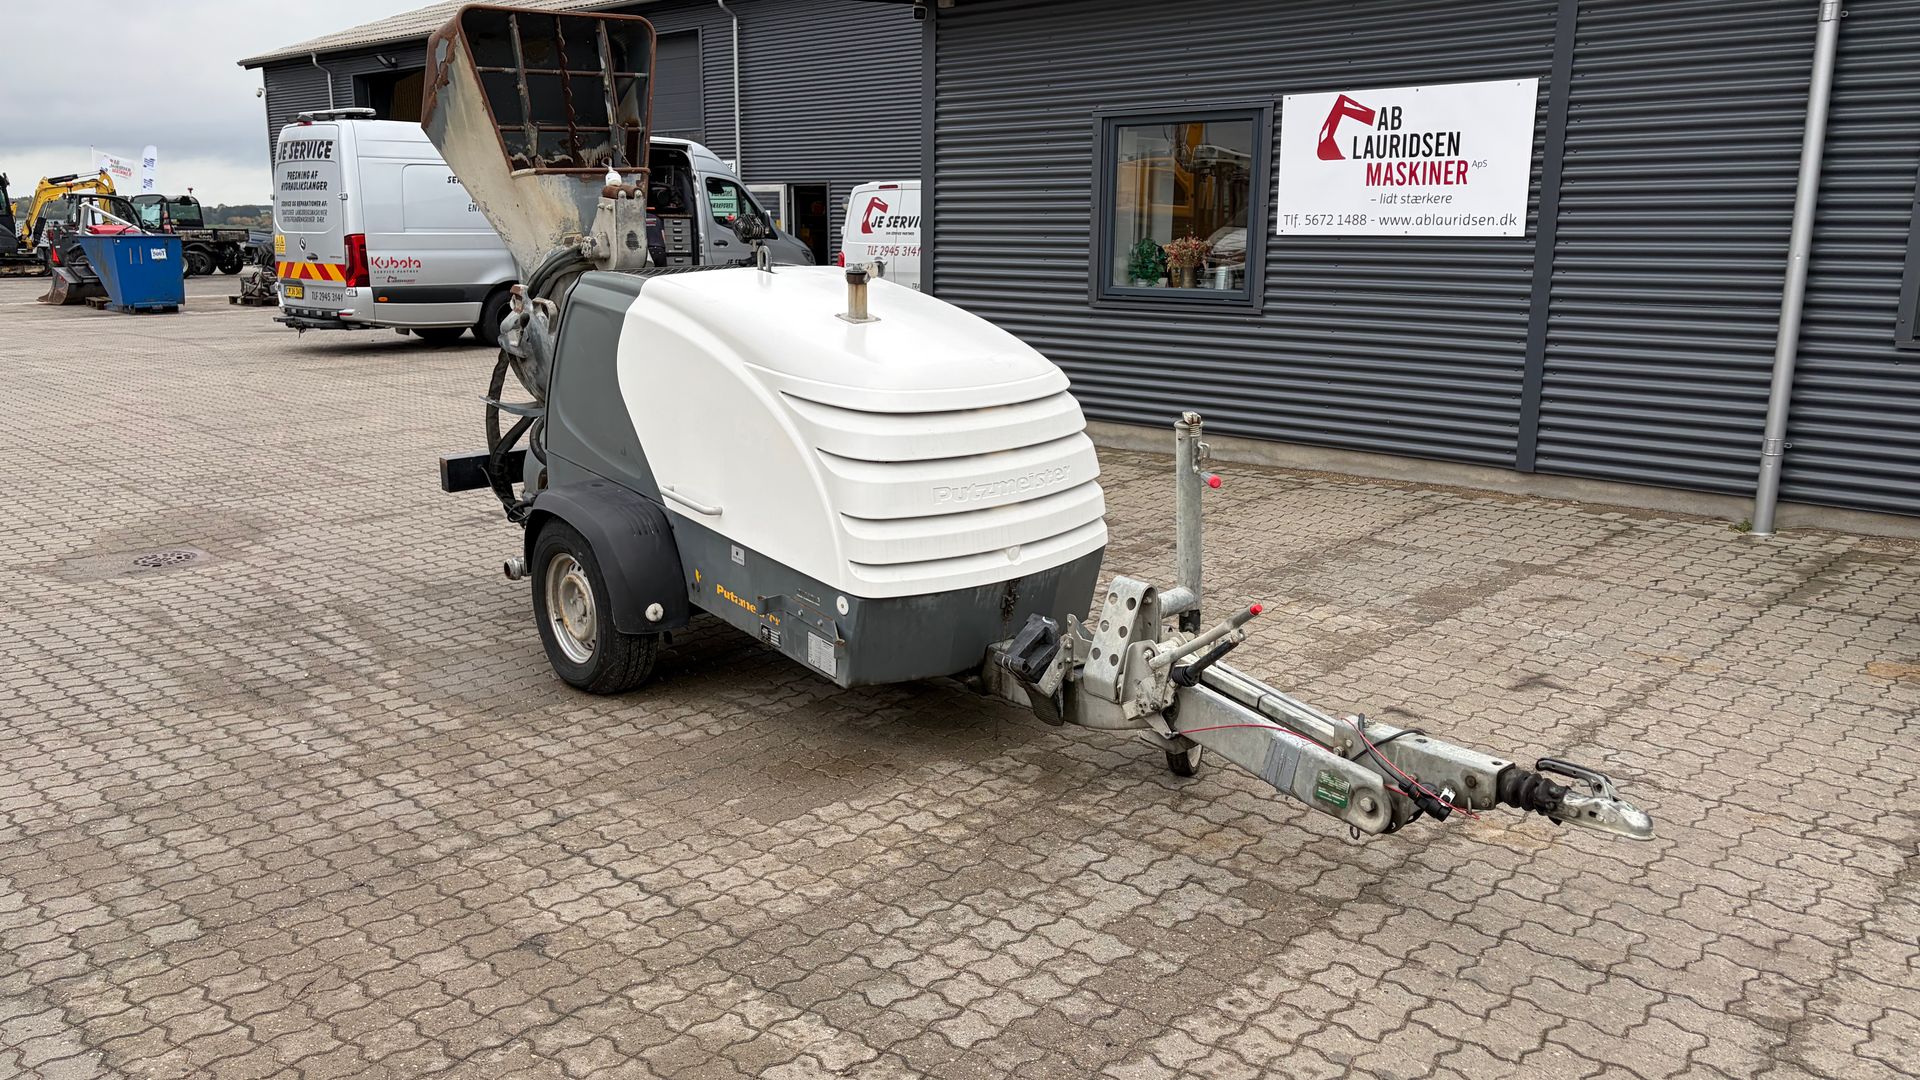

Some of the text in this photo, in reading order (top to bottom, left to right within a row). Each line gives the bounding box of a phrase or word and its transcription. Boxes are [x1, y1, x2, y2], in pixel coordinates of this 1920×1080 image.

[1377, 105, 1403, 131] AB
[278, 140, 334, 160] JE SERVICE
[1352, 131, 1461, 160] LAURIDSEN
[286, 170, 318, 180] PRESNING AF
[1365, 160, 1488, 187] MASKINER ApS
[1379, 193, 1398, 205] lidt
[1400, 193, 1453, 205] stærkere
[871, 216, 921, 229] JE SERVI
[1284, 214, 1301, 228] Tlf.
[1304, 214, 1334, 226] 5672
[1337, 214, 1367, 226] 1488
[1379, 213, 1518, 226] www.ablauridsen.dk
[867, 246, 921, 256] TLF 2945 3141
[371, 256, 421, 269] Kubota
[319, 292, 331, 301] 2945
[931, 464, 1071, 506] Putzmeister
